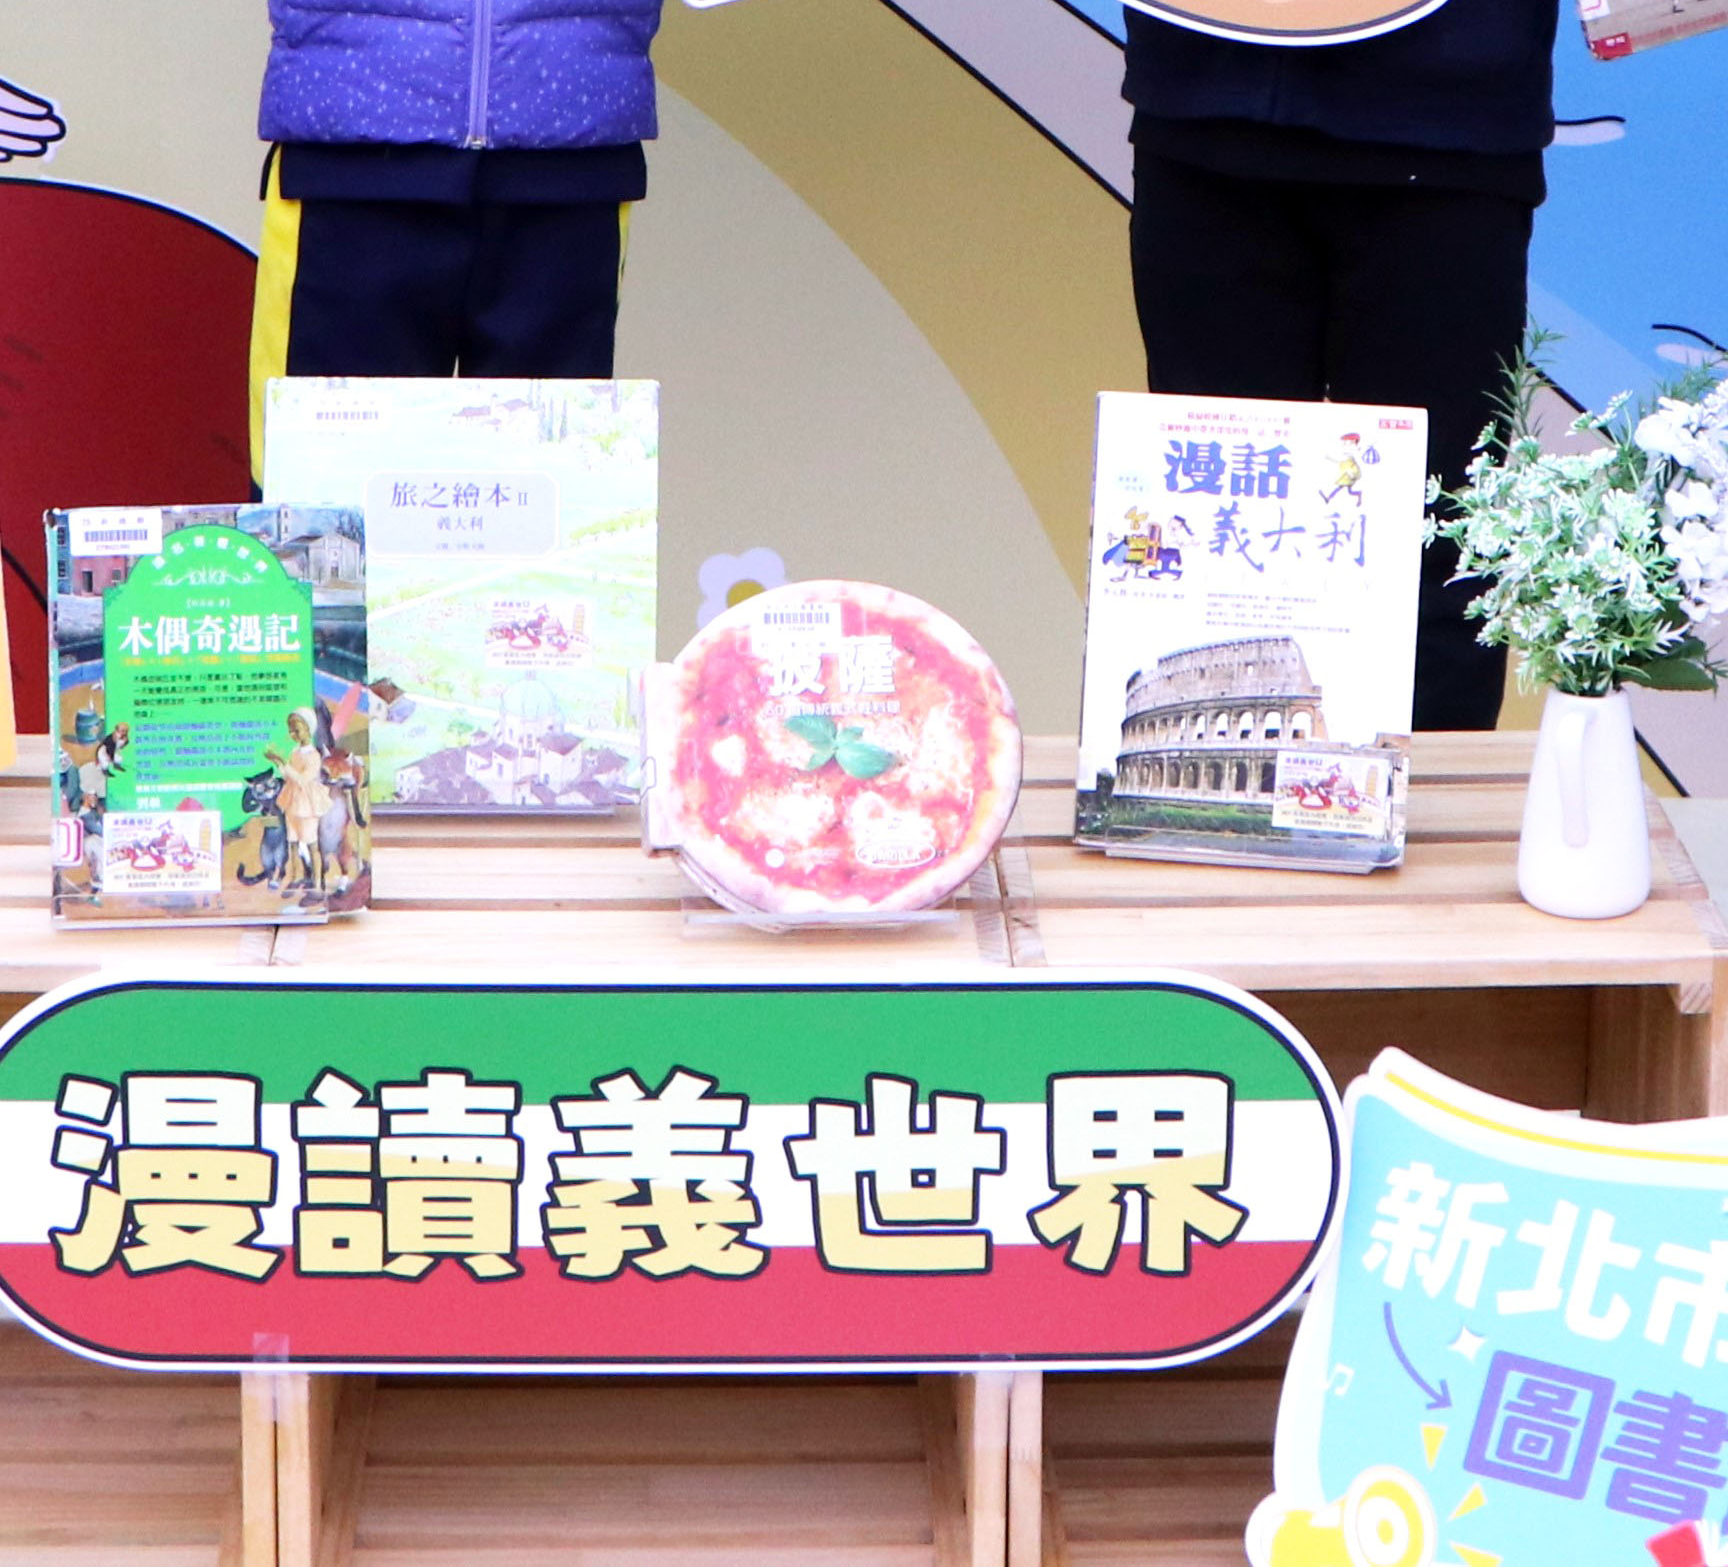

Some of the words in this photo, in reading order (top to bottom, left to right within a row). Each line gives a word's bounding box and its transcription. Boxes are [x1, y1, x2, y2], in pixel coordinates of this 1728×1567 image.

[1163, 439, 1293, 500] 漫話
[437, 516, 484, 531] 義大利
[1208, 500, 1367, 573] 義大利
[118, 613, 301, 656] 木偶奇遇記
[48, 1069, 1251, 1282] 漫讀義世界
